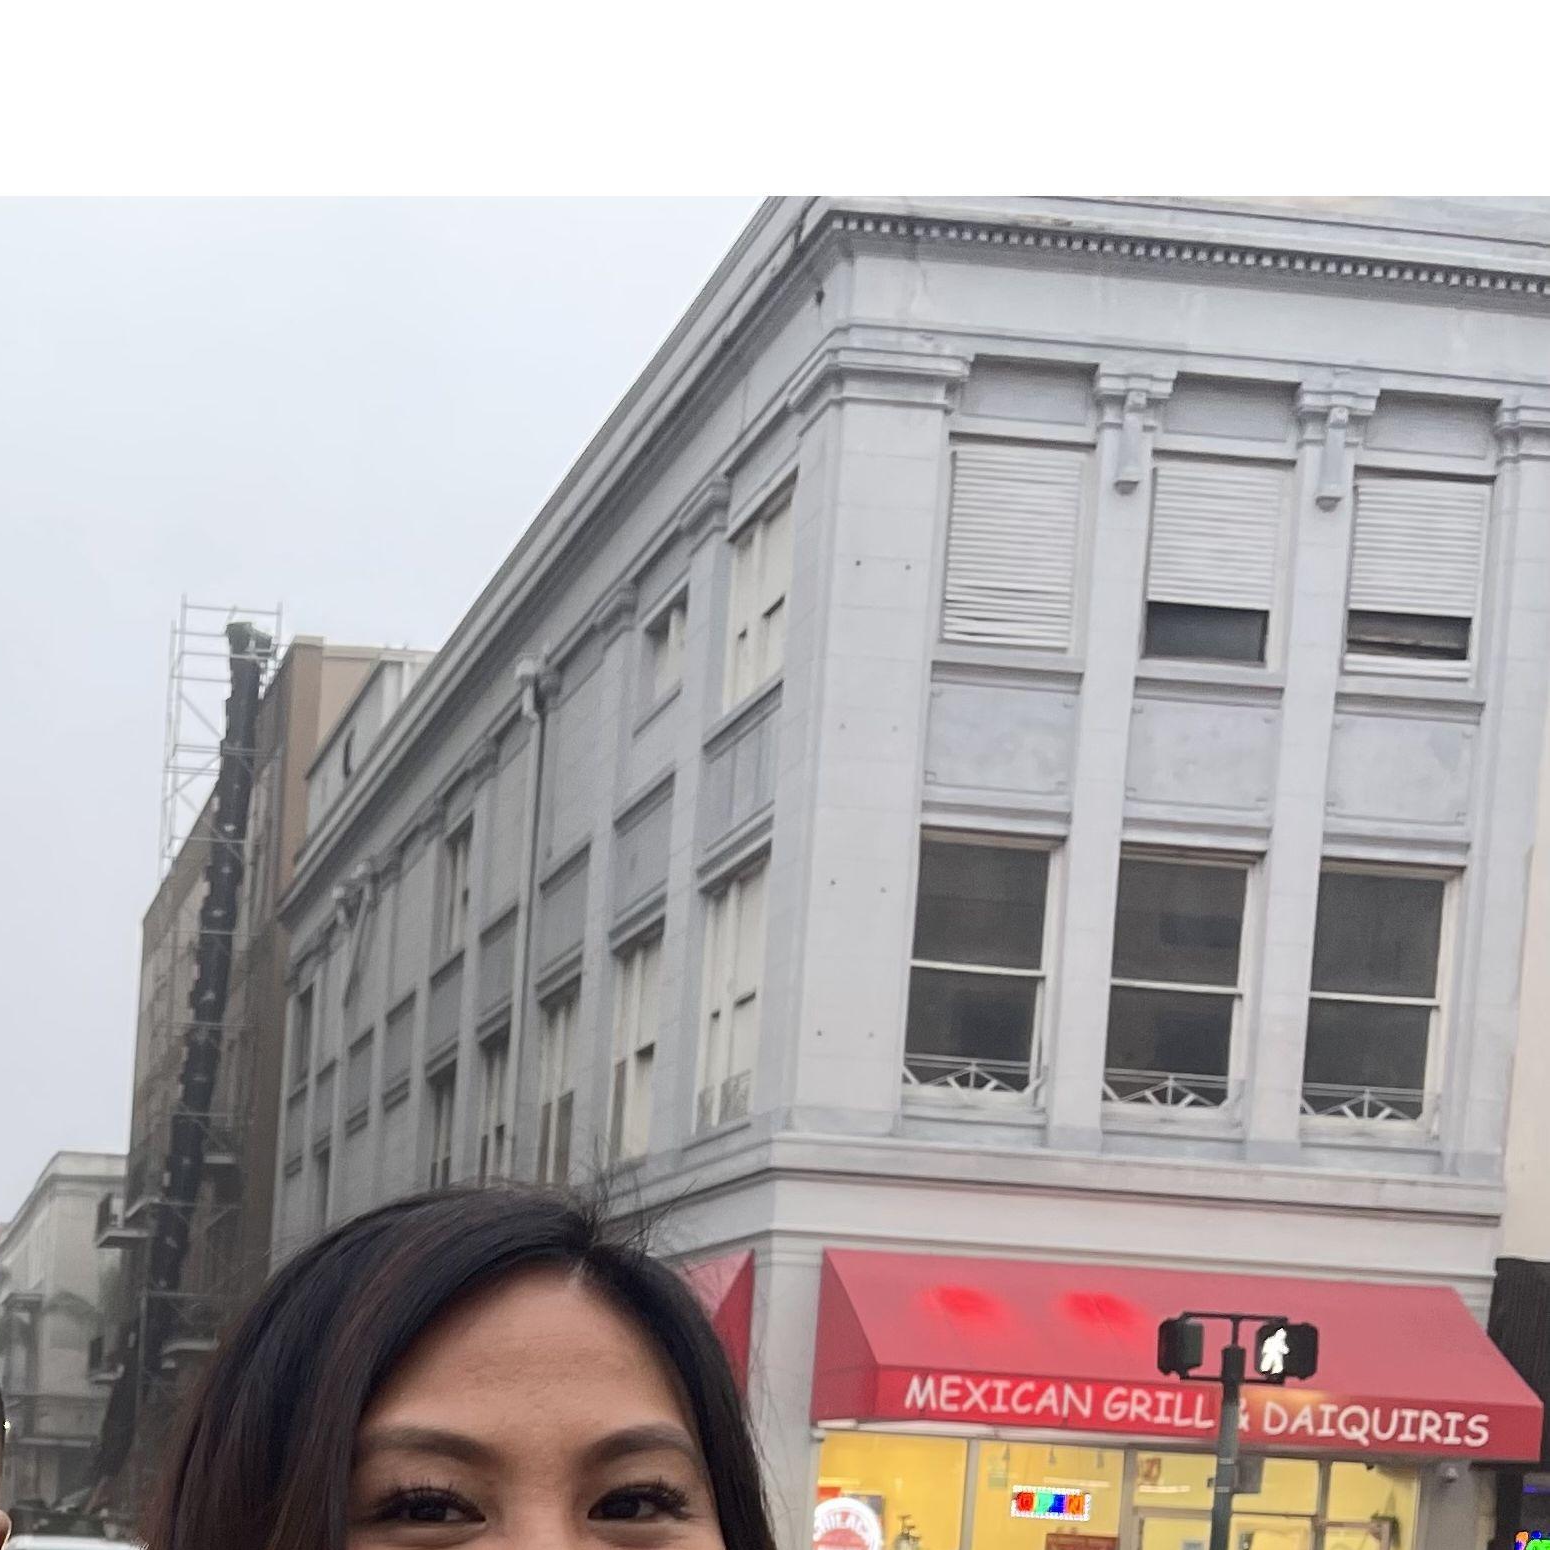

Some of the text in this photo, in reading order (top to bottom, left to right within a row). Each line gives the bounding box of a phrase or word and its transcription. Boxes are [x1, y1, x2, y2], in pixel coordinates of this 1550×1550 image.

[904, 1374, 1092, 1419] MEXICAN
[1103, 1386, 1215, 1429] GRILL
[1262, 1401, 1490, 1447] DAIQUIRIS
